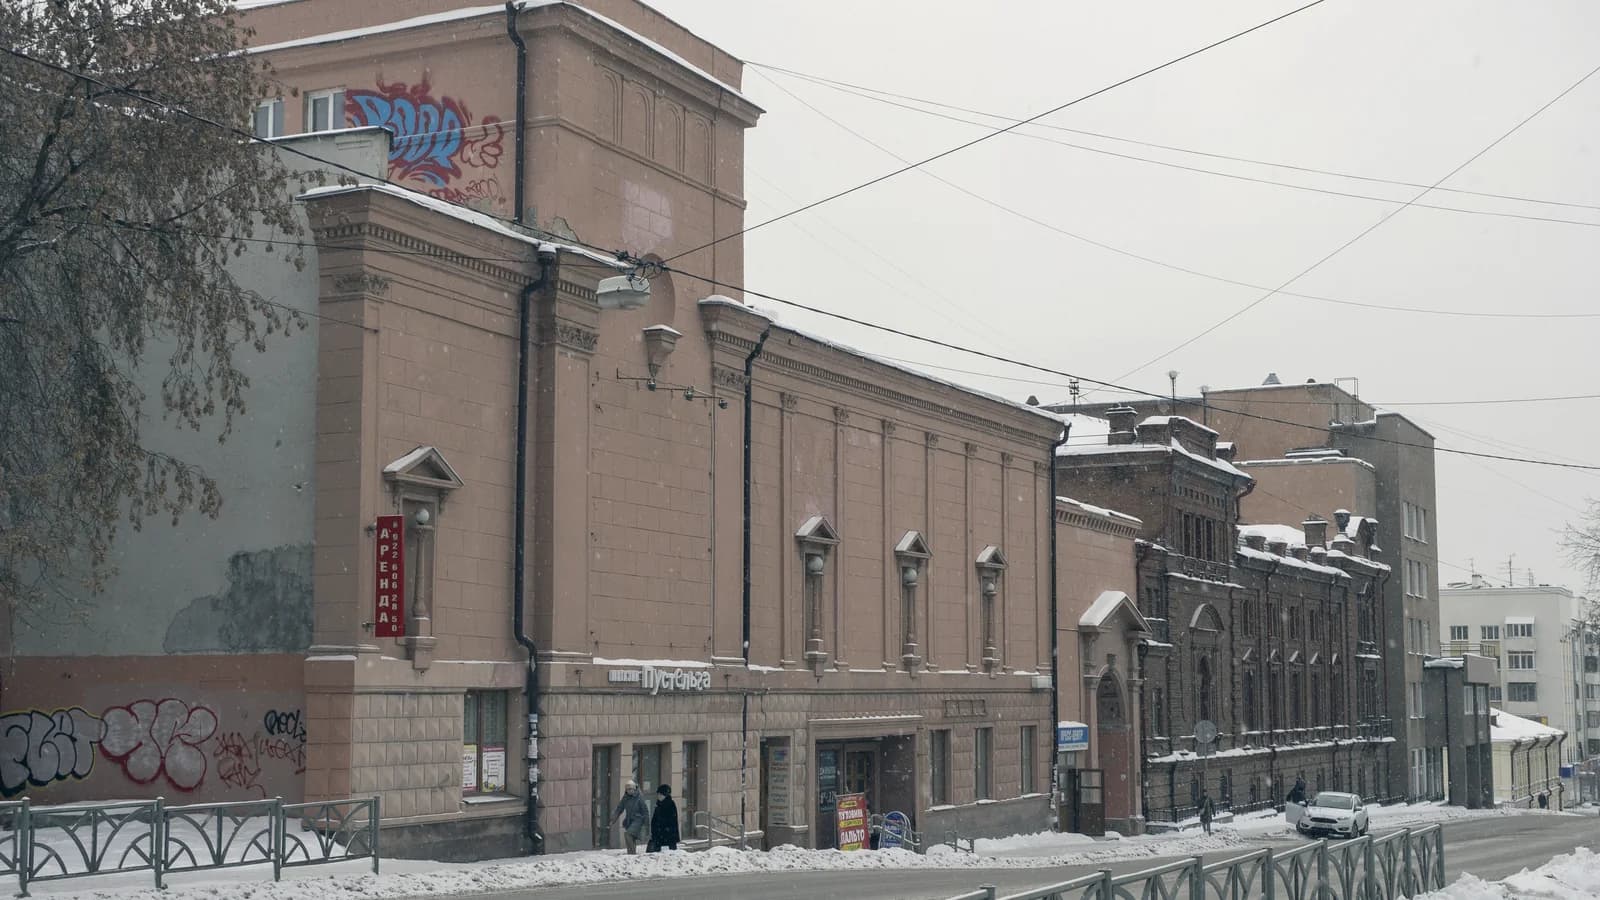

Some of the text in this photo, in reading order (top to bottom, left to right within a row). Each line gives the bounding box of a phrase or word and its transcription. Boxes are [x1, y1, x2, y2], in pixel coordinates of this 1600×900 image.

[379, 528, 389, 623] АРЕНДА
[392, 595, 398, 610] 28
[391, 615, 398, 632] 50
[643, 665, 711, 696] Пустельга
[840, 829, 865, 844] ПАЛЬТО
